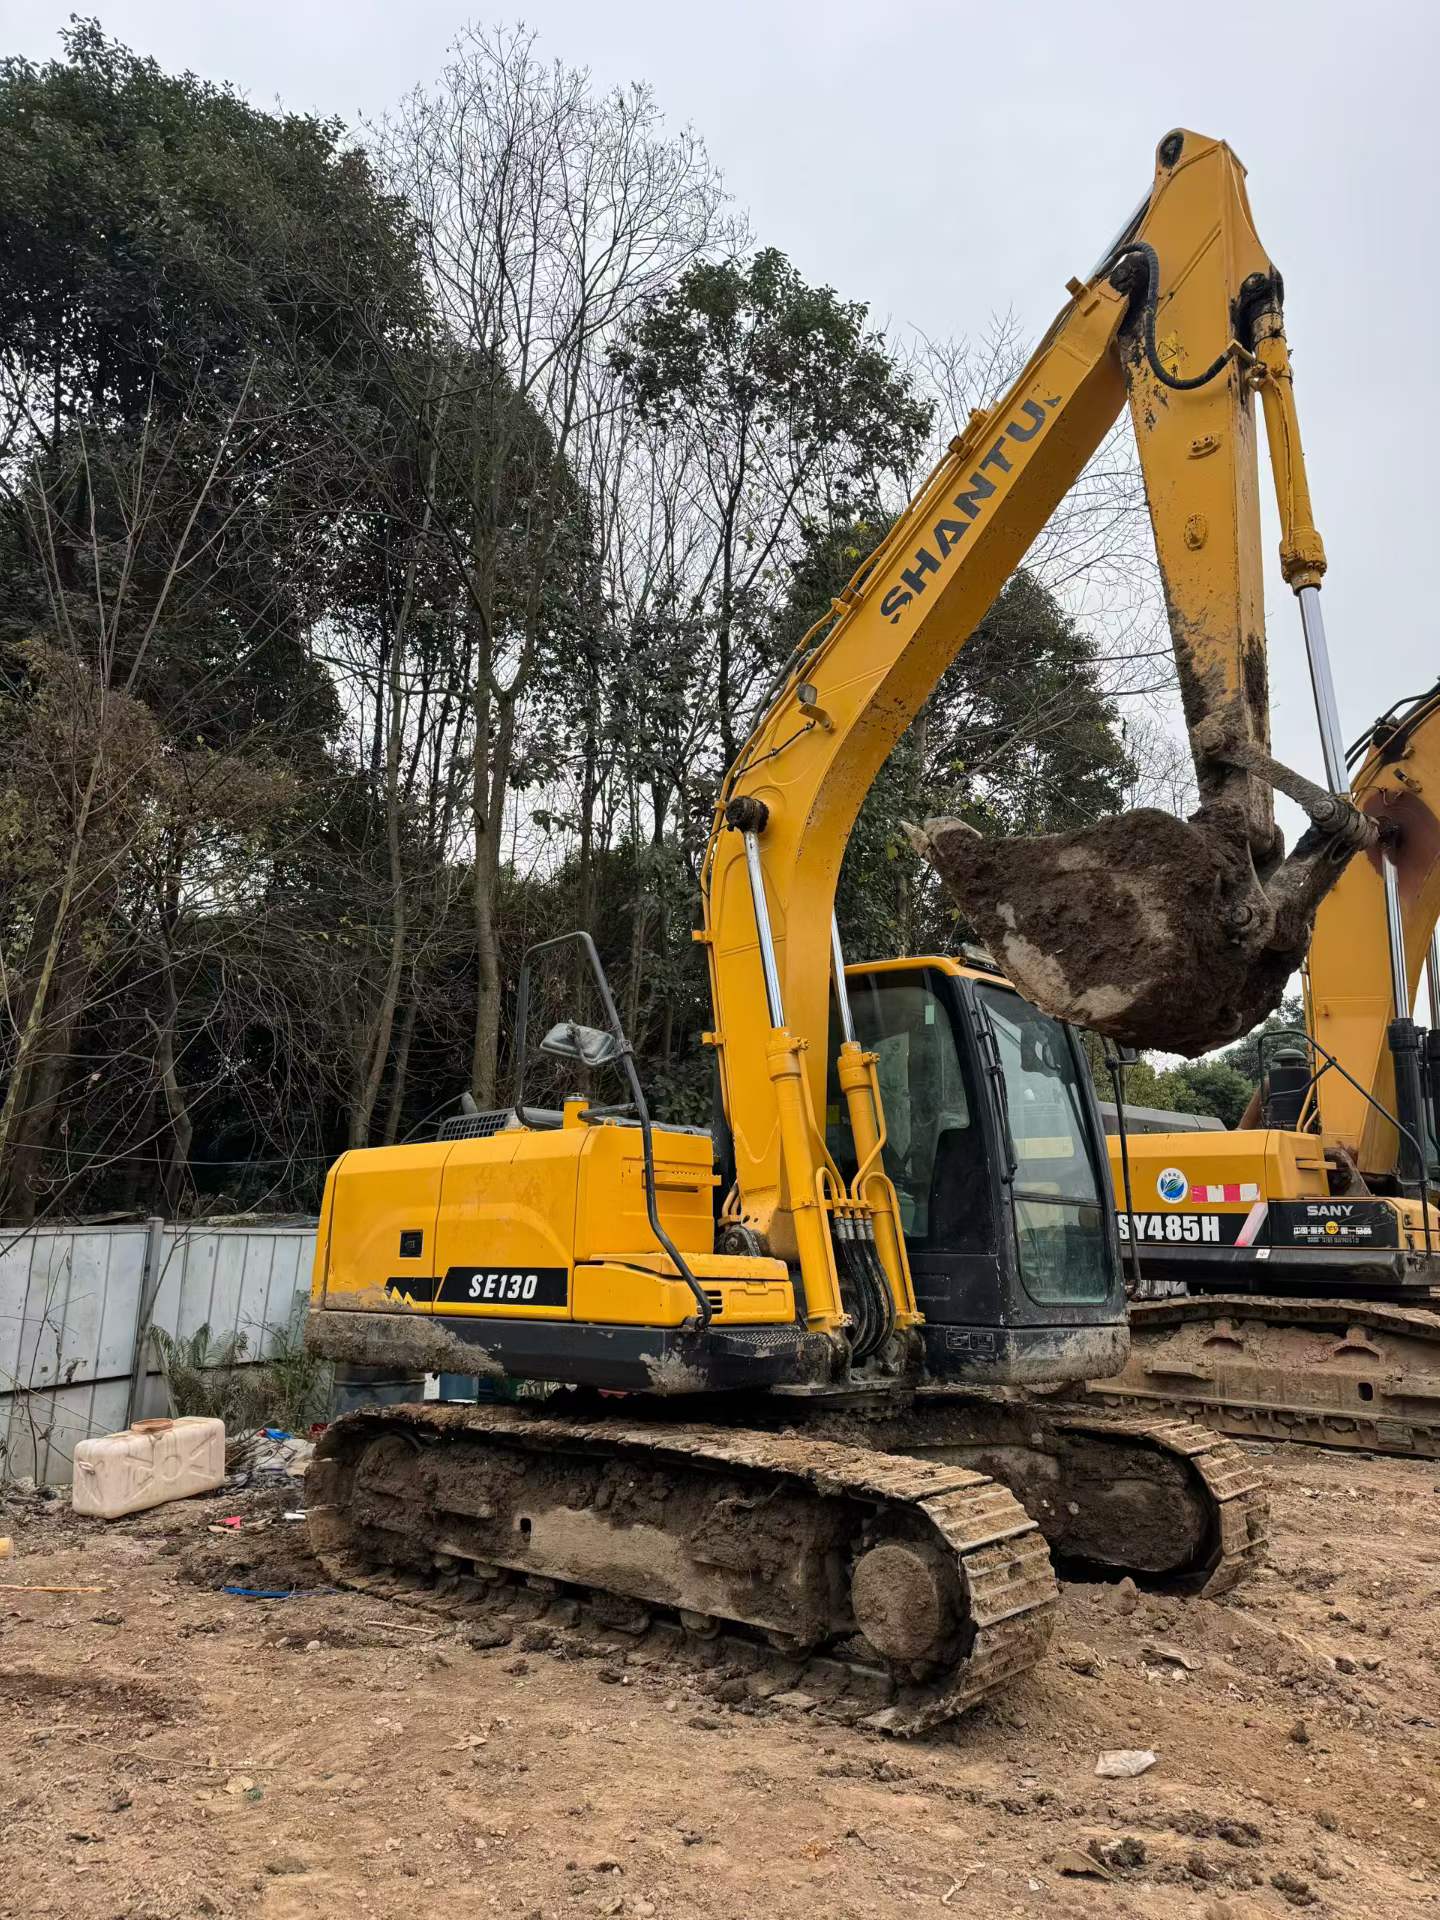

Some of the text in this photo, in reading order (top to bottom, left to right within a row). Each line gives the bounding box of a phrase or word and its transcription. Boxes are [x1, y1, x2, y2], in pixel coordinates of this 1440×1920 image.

[880, 396, 1062, 624] SHANTU
[1307, 1205, 1354, 1216] SANY
[1117, 1214, 1219, 1241] SY485H
[469, 1274, 538, 1299] SE130
